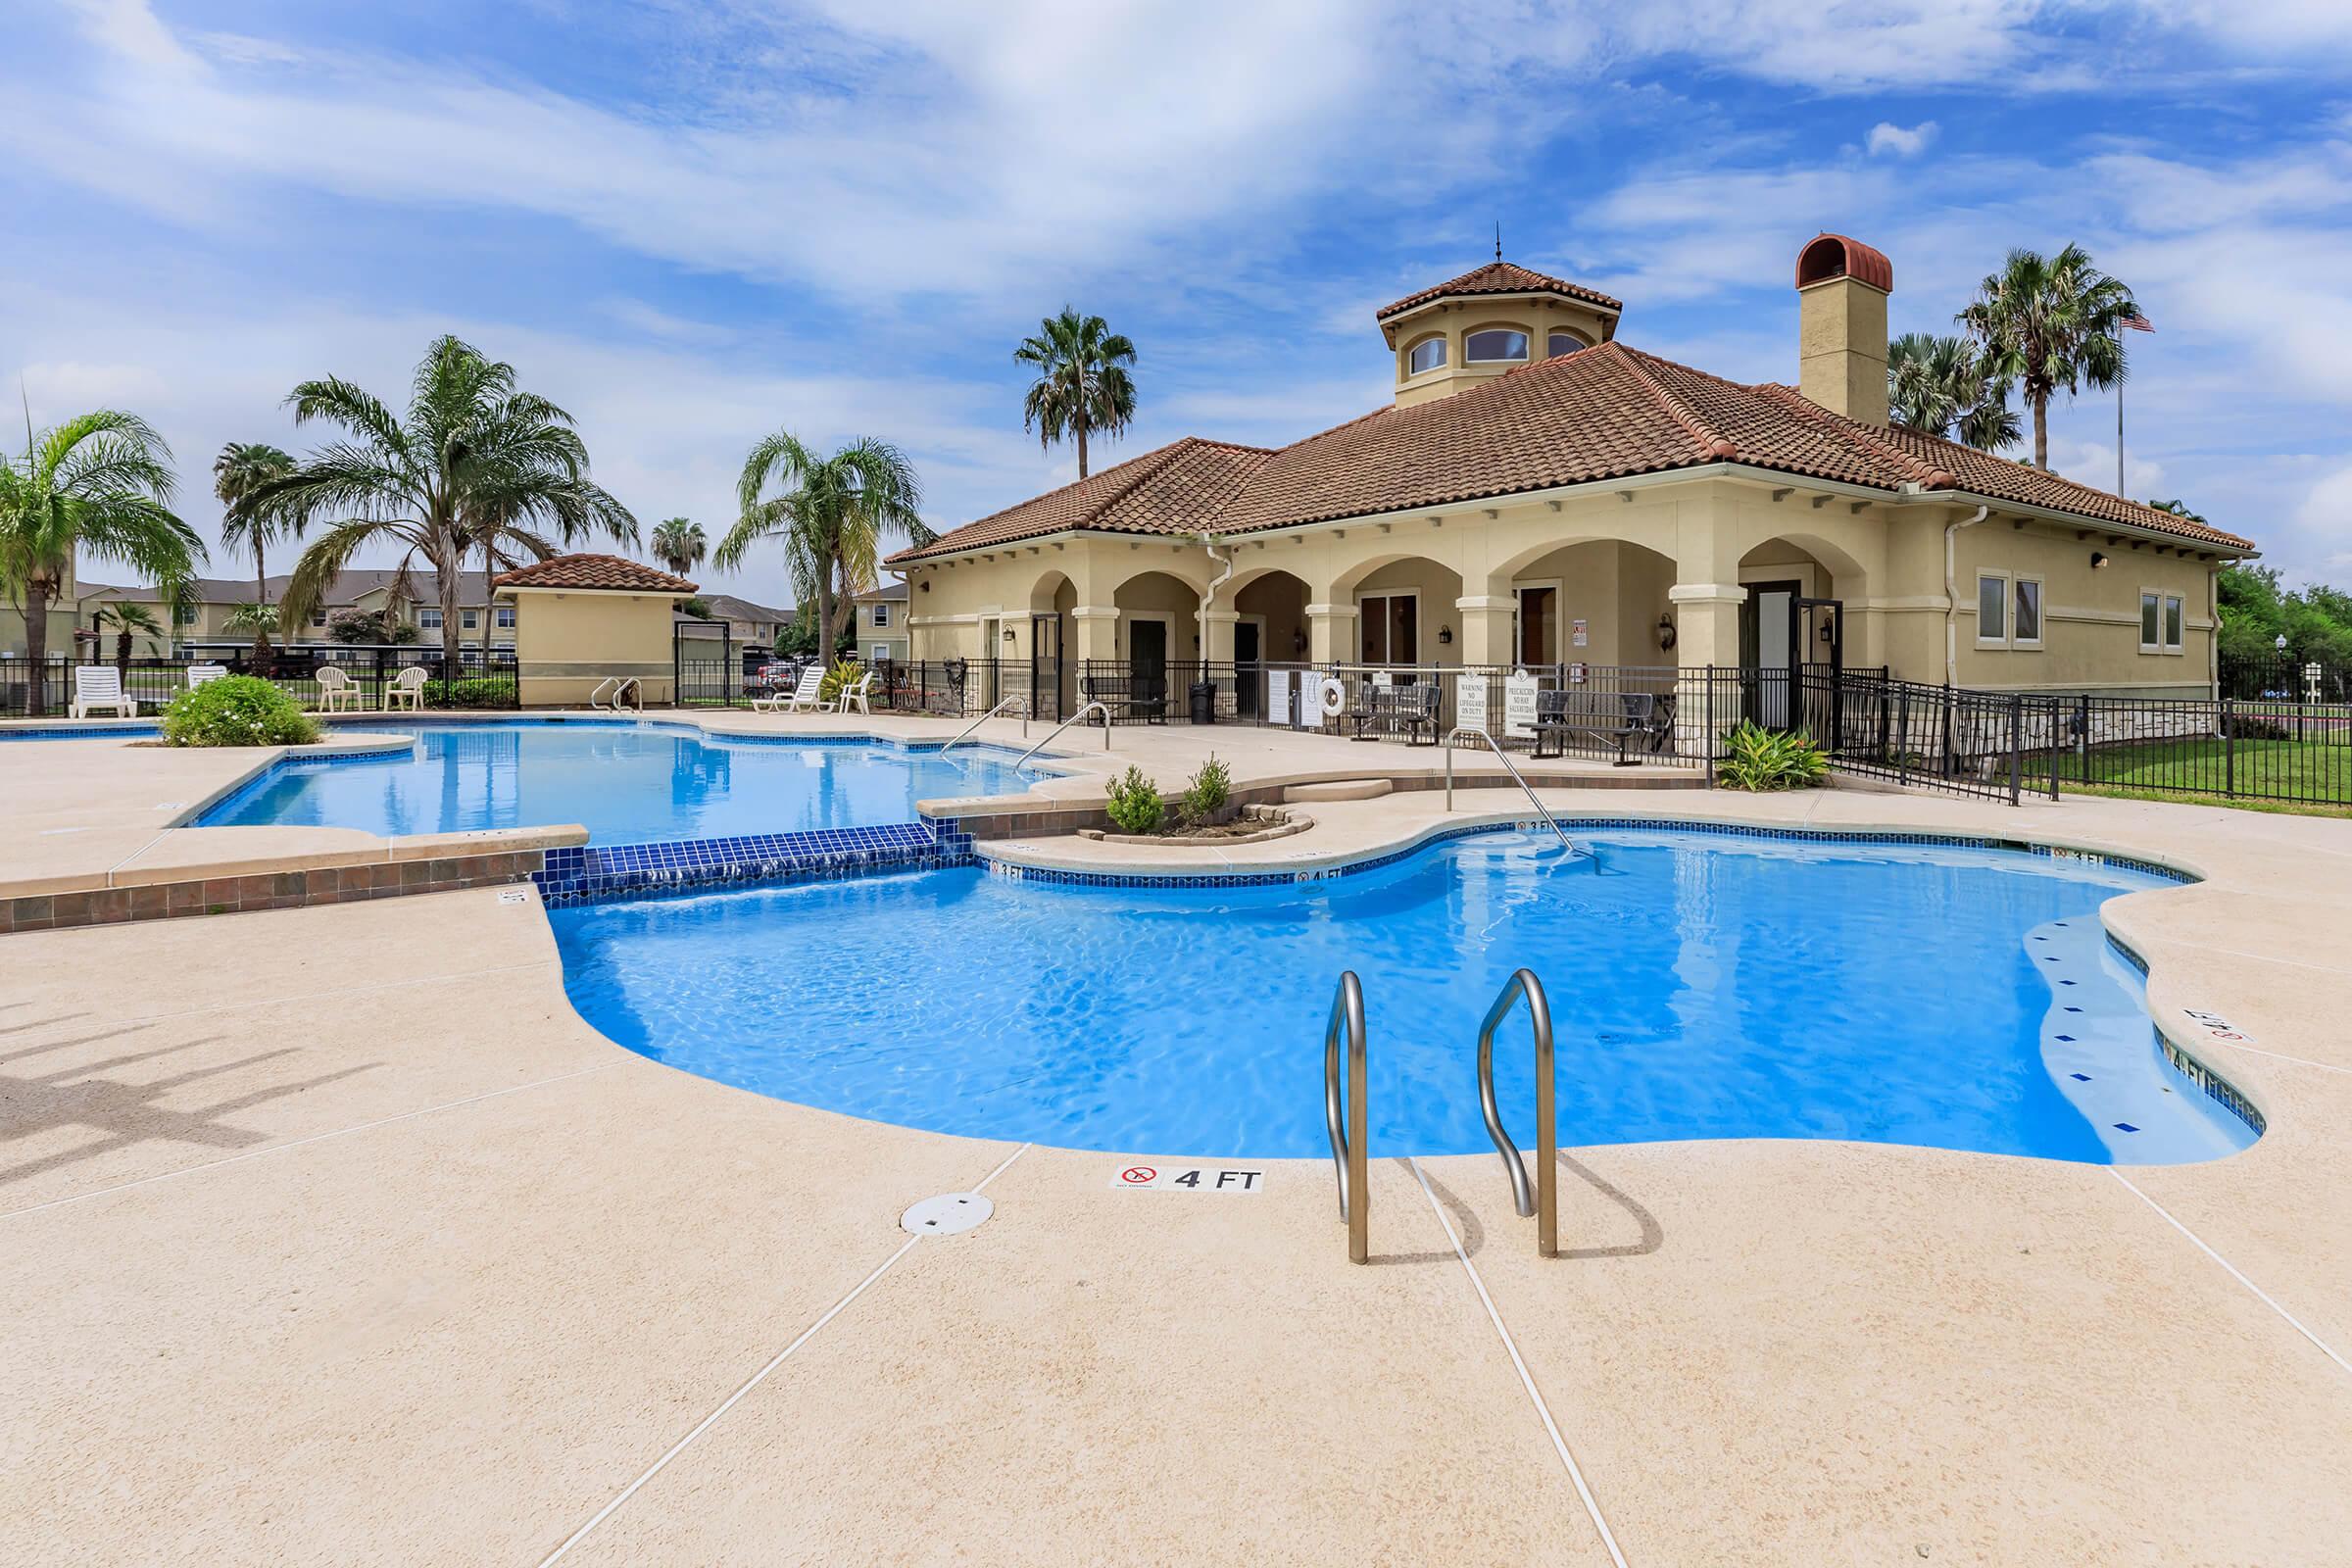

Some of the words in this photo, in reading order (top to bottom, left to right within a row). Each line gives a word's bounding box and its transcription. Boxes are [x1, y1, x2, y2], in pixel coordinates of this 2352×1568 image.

[1010, 865, 1021, 879] FT
[2187, 1058, 2203, 1087] FT
[1174, 1170, 1200, 1189] 4
[1216, 1170, 1262, 1190] FT
